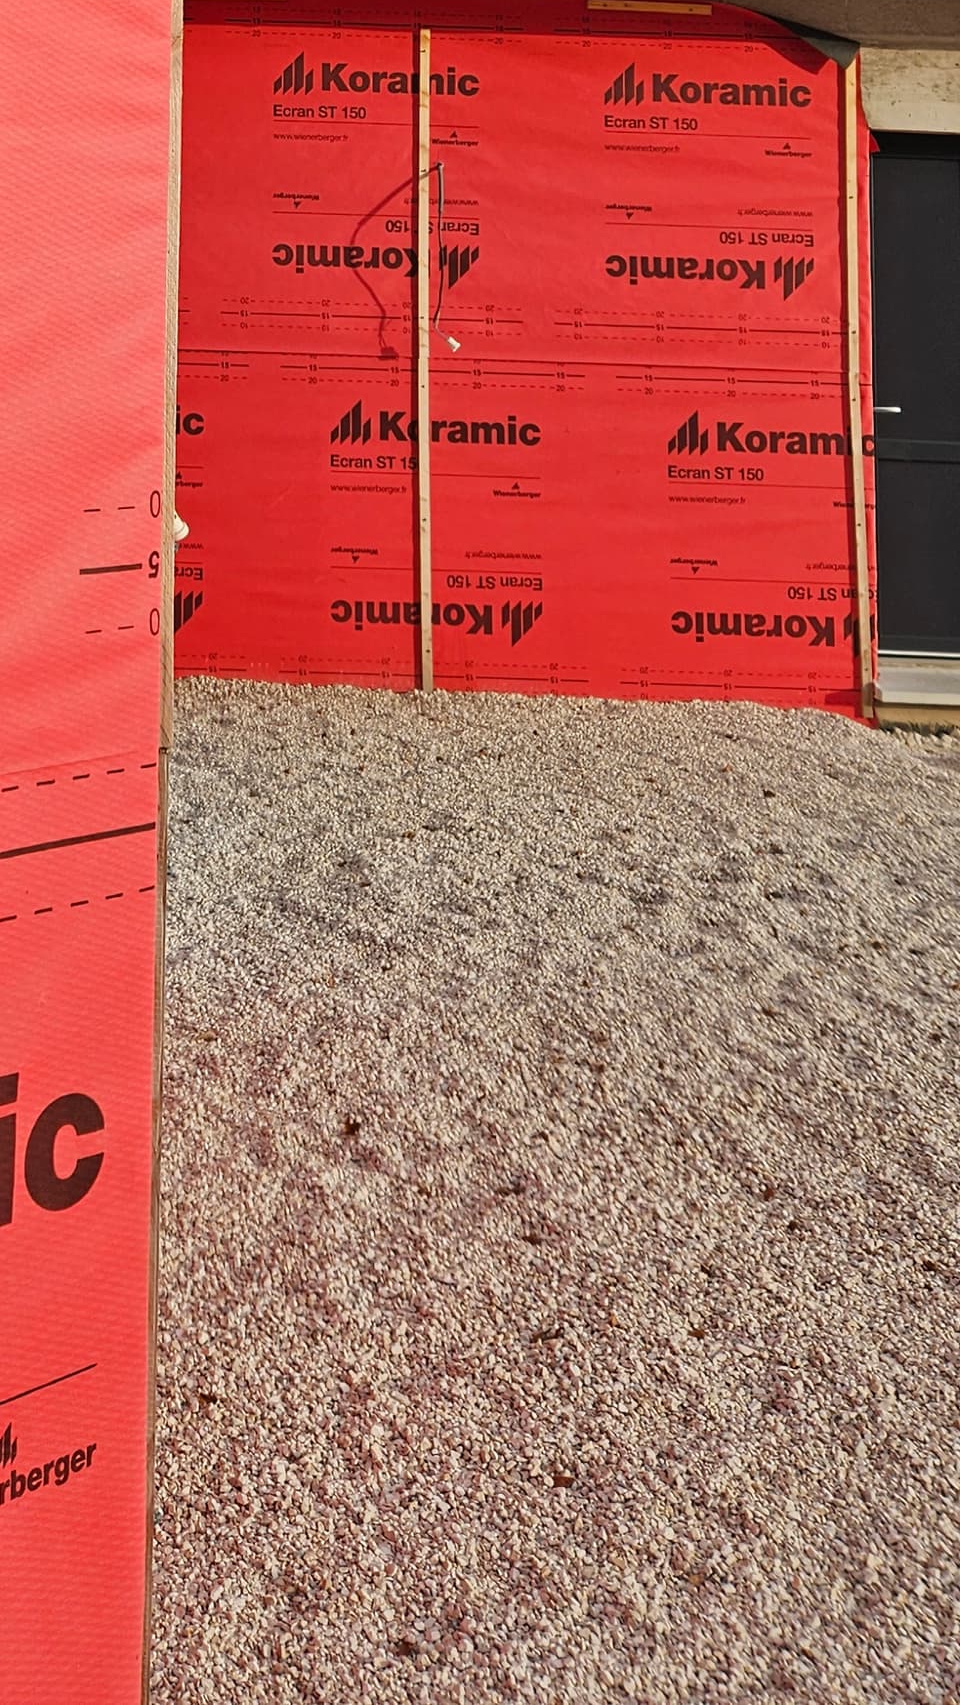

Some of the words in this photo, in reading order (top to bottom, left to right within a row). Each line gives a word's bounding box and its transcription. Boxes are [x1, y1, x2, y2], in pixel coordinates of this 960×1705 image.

[652, 73, 812, 108] Koramic
[273, 105, 315, 119] Ecran
[318, 106, 337, 119] ST
[342, 107, 367, 119] 150
[604, 115, 646, 129] Ecran
[649, 116, 668, 130] ST
[673, 118, 698, 131] 150
[385, 220, 410, 233] 150
[719, 231, 743, 244] 150
[748, 232, 768, 245] ST
[773, 233, 814, 247] Ecran
[605, 254, 766, 289] Koramic
[220, 374, 229, 382] 20
[472, 382, 482, 390] 20
[330, 455, 373, 469] Ecran
[376, 456, 396, 469] ST
[668, 465, 711, 480] Ecran
[714, 467, 735, 480] ST
[739, 468, 764, 481] 150
[447, 575, 472, 588] 150
[476, 576, 497, 589] ST
[500, 578, 543, 591] Ecran
[788, 586, 814, 600] 150
[817, 587, 837, 601] ST
[671, 610, 836, 648] Koramic
